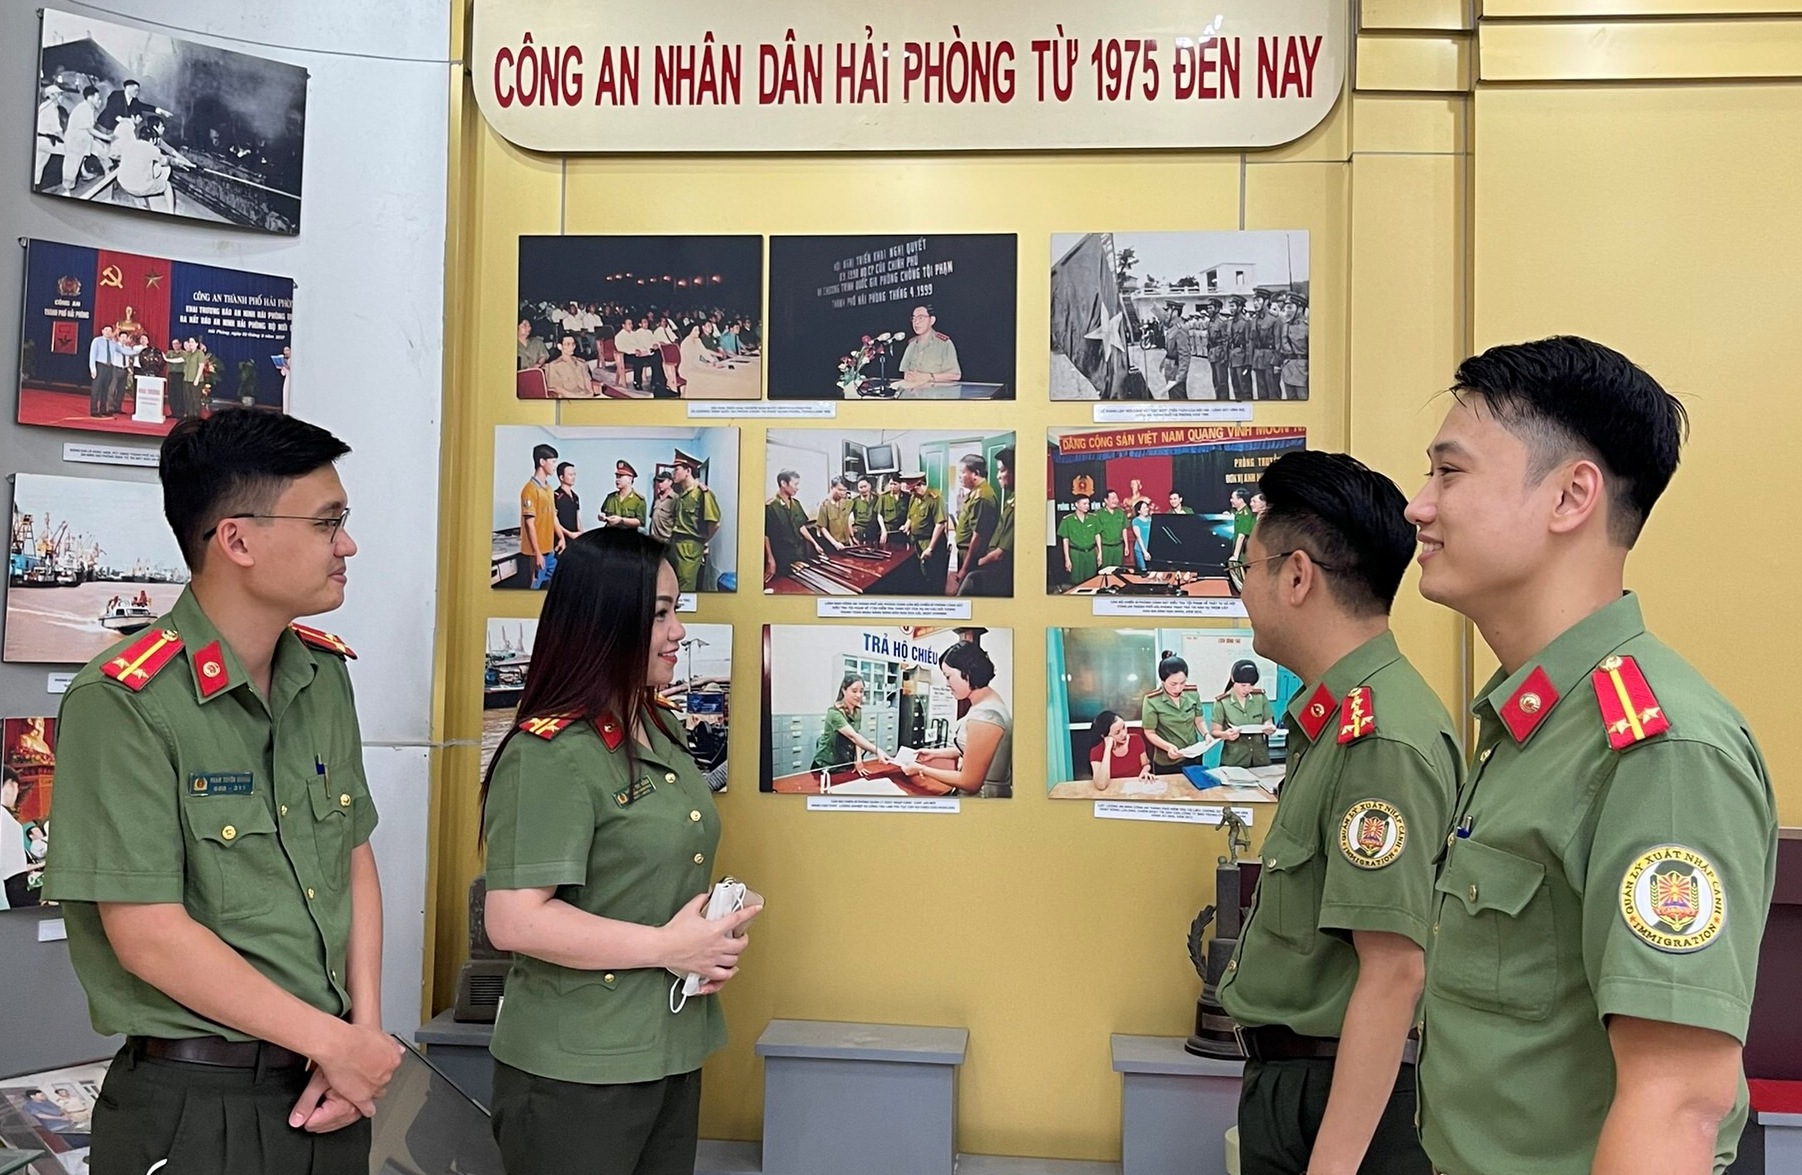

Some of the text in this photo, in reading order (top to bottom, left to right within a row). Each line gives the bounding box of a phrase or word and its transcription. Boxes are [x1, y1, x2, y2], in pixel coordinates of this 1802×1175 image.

[494, 15, 1322, 108] CÔNG AN NHÂN DÂN HẢI PHÒNG TỪ 1975 ĐẾN NAY
[906, 237, 926, 255] QUYẾT
[923, 264, 933, 279] TỘI
[935, 261, 953, 275] PHẠM
[193, 291, 210, 301] CÔNG
[212, 294, 222, 302] AN
[224, 294, 247, 305] THÀNH
[1089, 435, 1113, 450] CỘNG
[1116, 432, 1134, 446] SẢN
[1137, 430, 1157, 446] VIỆT
[1162, 430, 1184, 443] NAM
[1188, 428, 1223, 440] QUANG
[1228, 427, 1252, 437] VINH
[863, 633, 938, 665] TRẢ HỘ CHIẾU
[1344, 848, 1394, 866] IMMIGRATION
[1633, 923, 1716, 947] IMMIGRATION
